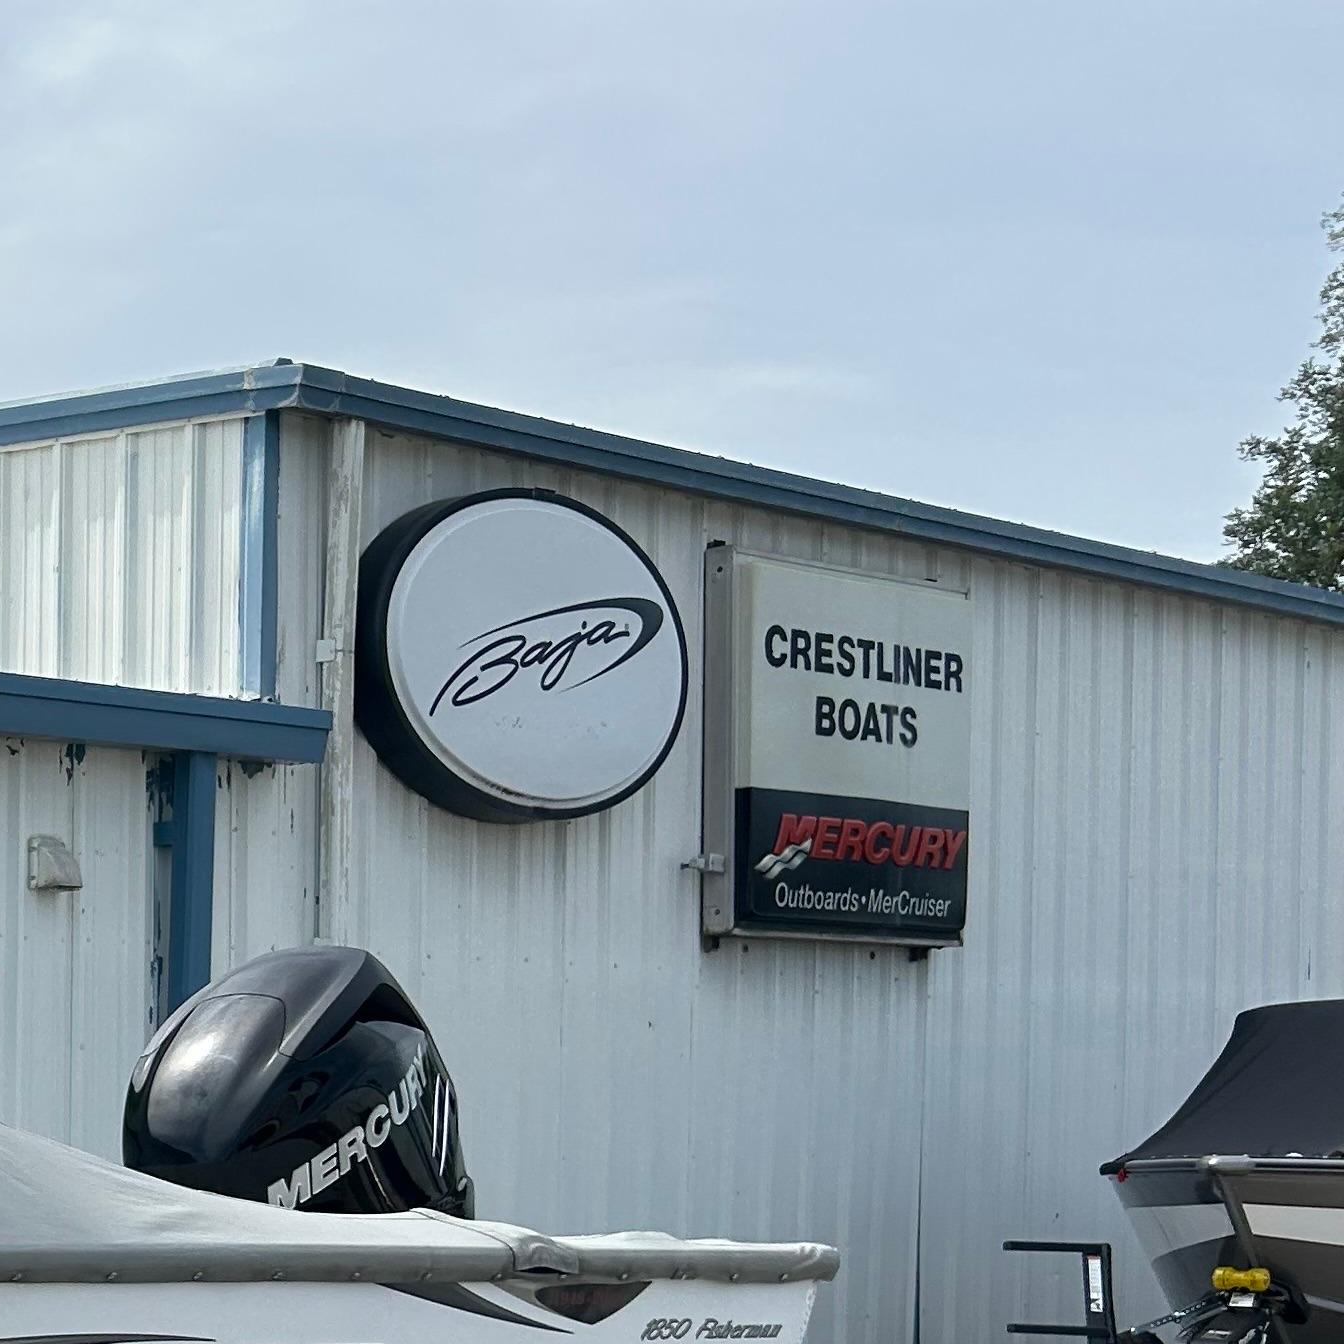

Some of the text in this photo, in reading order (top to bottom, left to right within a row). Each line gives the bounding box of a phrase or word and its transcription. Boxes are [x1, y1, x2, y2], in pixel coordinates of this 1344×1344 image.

[428, 620, 631, 717] Baja
[764, 624, 964, 693] CRESTLINER
[815, 696, 918, 748] BOATS
[772, 813, 967, 871] MERCURY
[267, 1043, 428, 1210] MERCURY
[641, 1317, 783, 1341] 1850 Fisherman
